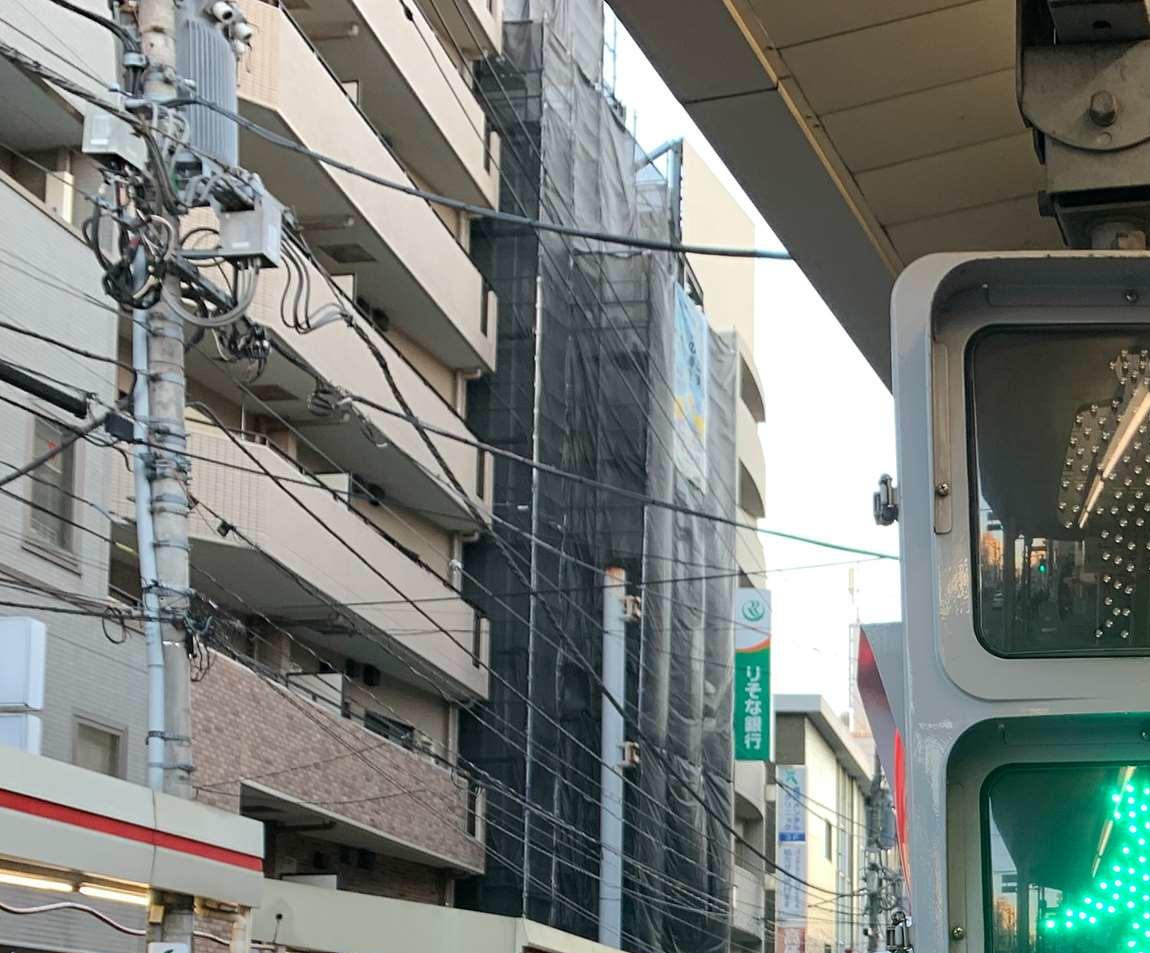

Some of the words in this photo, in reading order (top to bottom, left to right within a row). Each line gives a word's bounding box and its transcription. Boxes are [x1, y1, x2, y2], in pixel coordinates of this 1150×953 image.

[744, 665, 762, 750] りそな銀行
